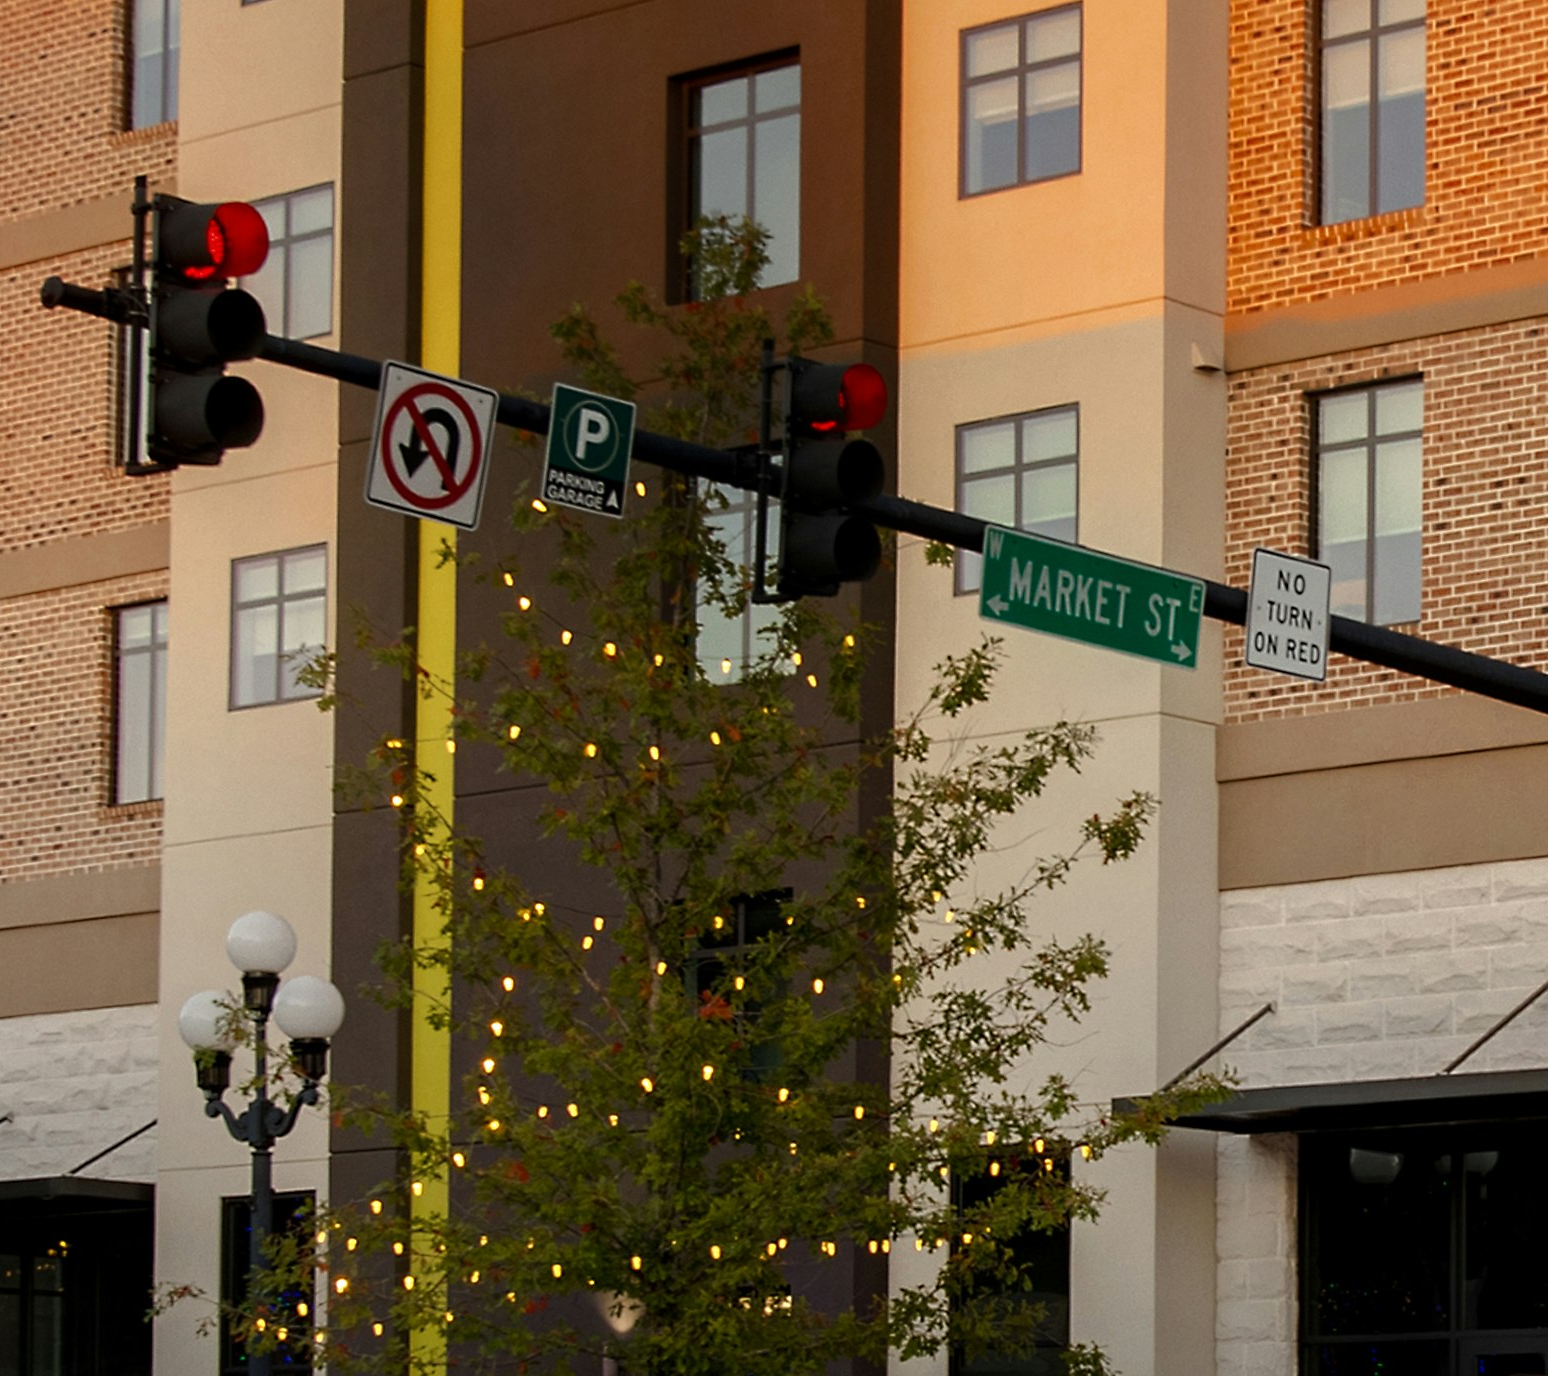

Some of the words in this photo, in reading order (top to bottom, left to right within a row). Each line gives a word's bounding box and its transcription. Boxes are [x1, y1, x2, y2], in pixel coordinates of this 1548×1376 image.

[575, 407, 610, 460] P
[547, 484, 604, 511] GARAGE
[549, 468, 605, 495] PARKING
[989, 529, 1005, 561] W
[1008, 556, 1132, 628] MARKET
[1143, 592, 1182, 642] ST
[1188, 584, 1202, 613] E
[1277, 568, 1306, 596] NO
[1267, 599, 1313, 631] TURN
[1254, 630, 1278, 656] ON
[1285, 637, 1320, 665] RED
